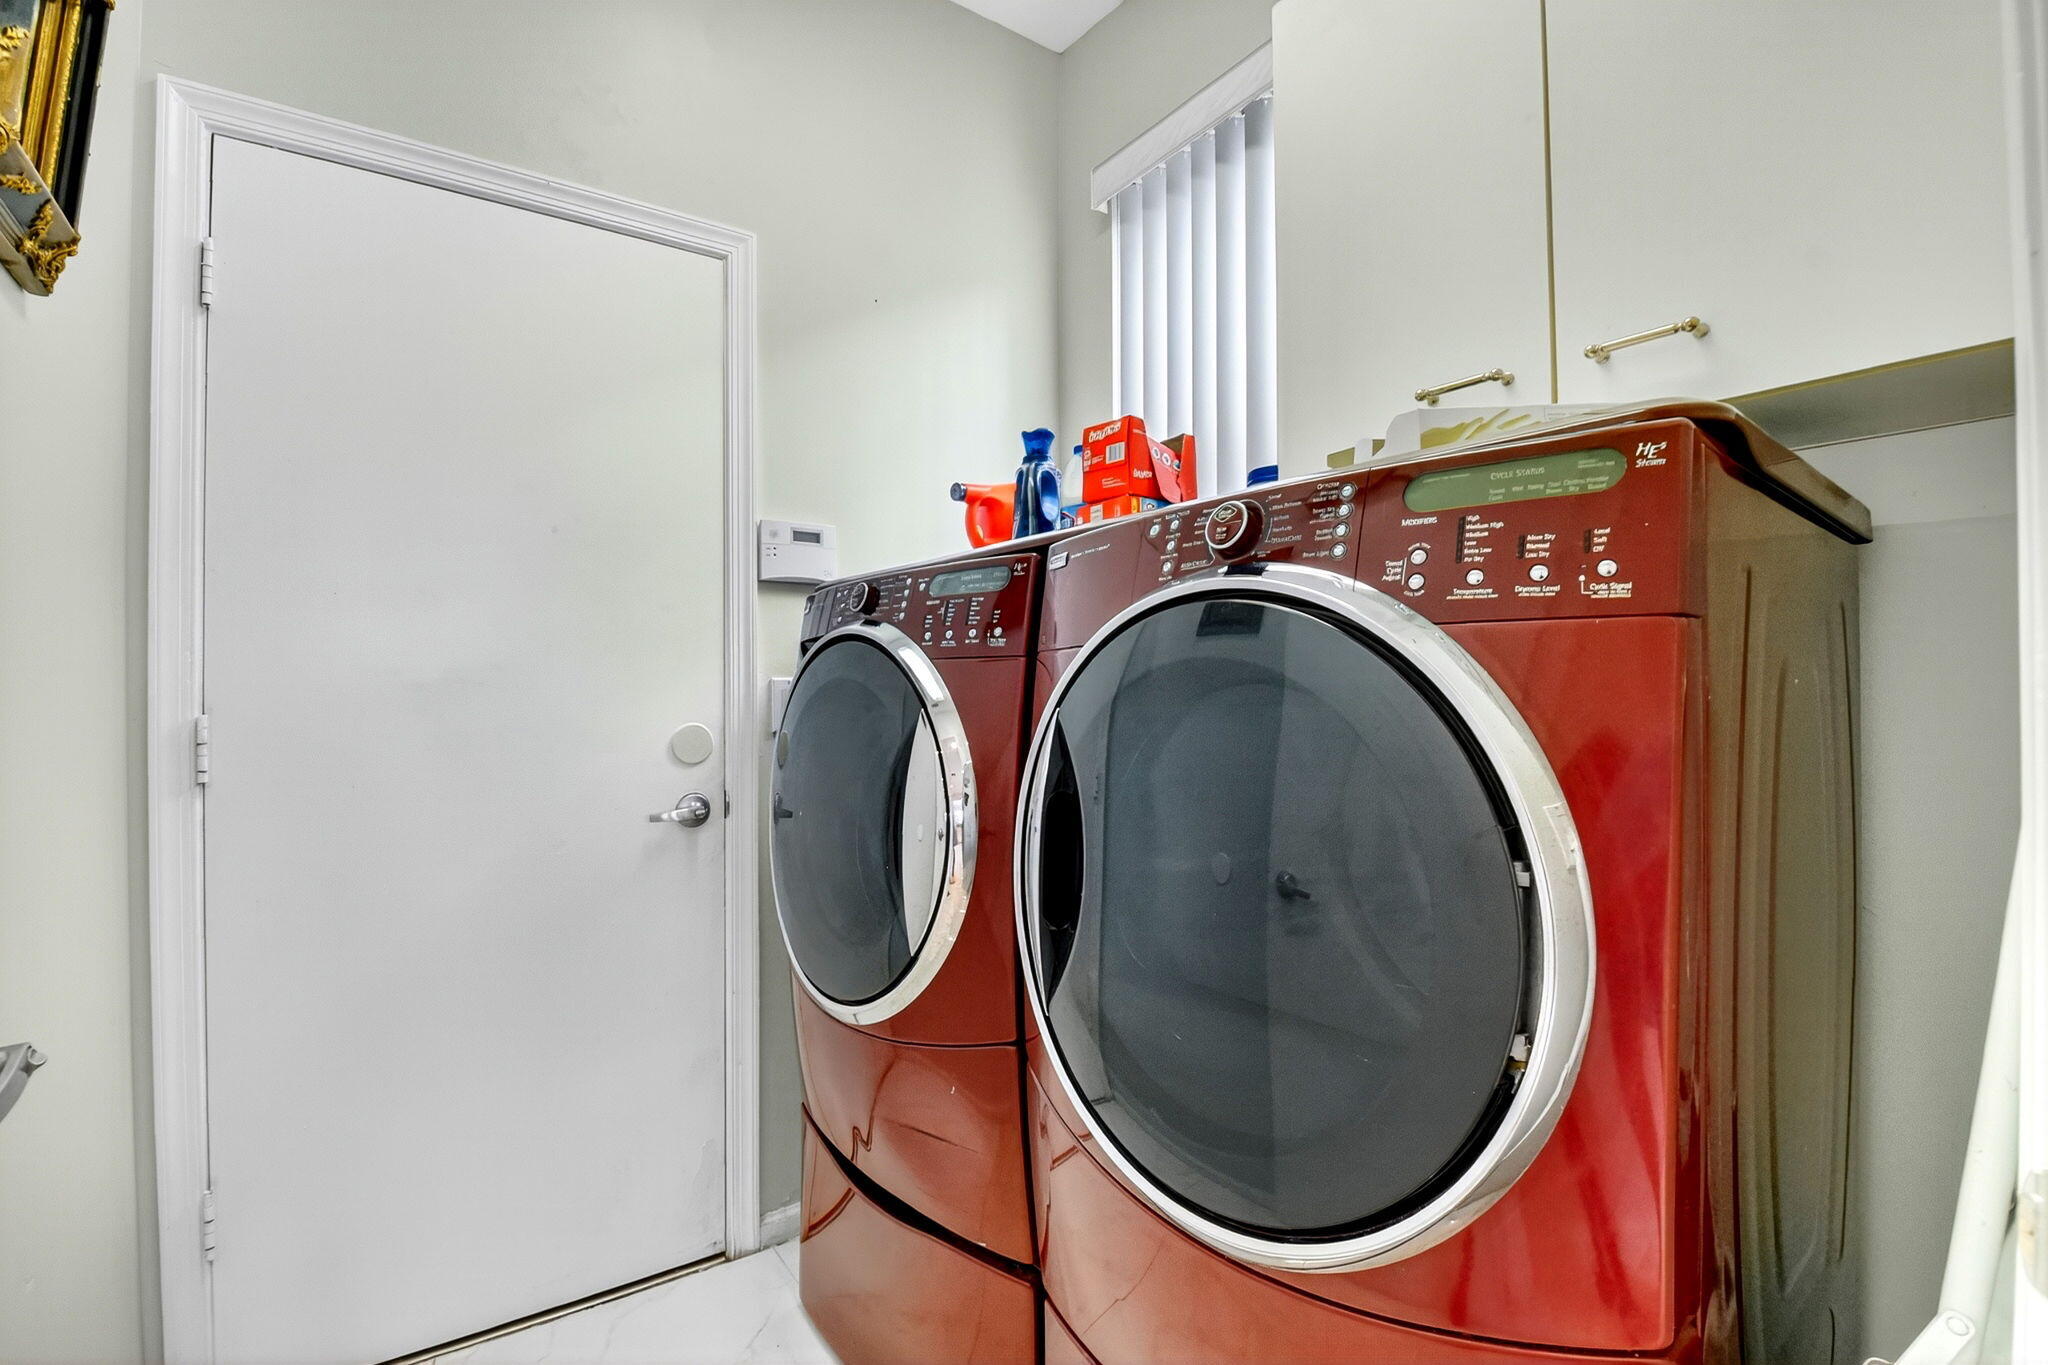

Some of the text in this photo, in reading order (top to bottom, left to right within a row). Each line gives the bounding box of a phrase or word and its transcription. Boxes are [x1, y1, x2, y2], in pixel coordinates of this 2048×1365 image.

[1635, 458, 1667, 469] Steam
[1490, 467, 1546, 481] CYCLE STATUS
